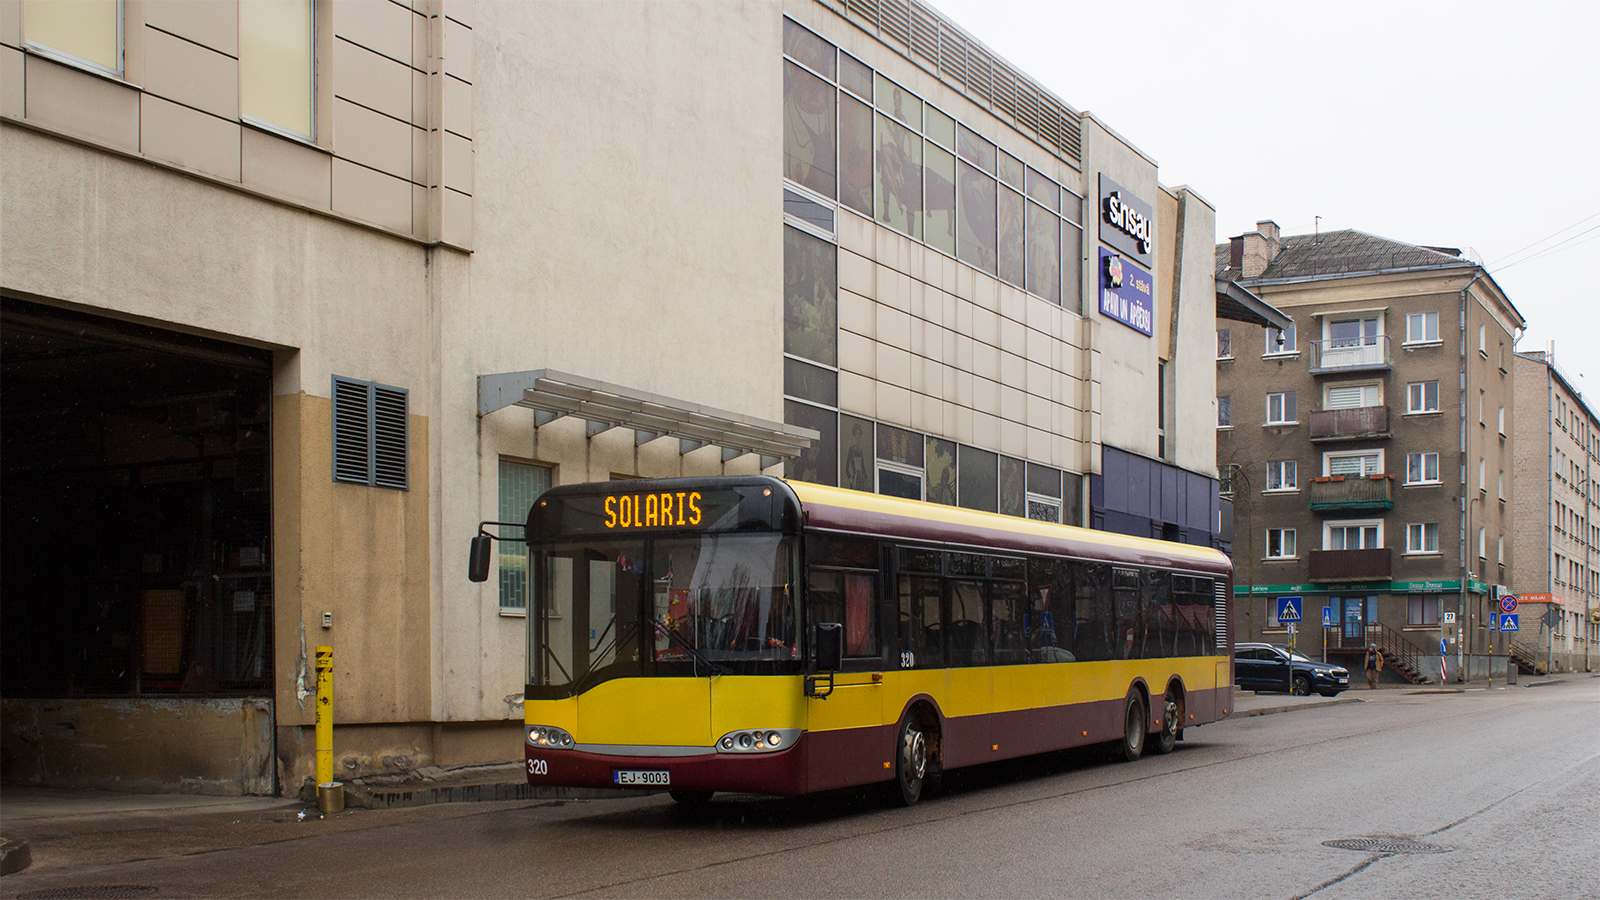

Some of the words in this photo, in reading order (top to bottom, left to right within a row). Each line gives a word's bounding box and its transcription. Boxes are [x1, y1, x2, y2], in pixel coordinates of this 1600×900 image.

[1109, 191, 1152, 254] sinsay
[1119, 297, 1128, 321] UN
[604, 491, 702, 528] SOLARIS
[900, 652, 914, 668] 320
[528, 758, 548, 775] 320
[620, 772, 669, 784] EJ-9003
